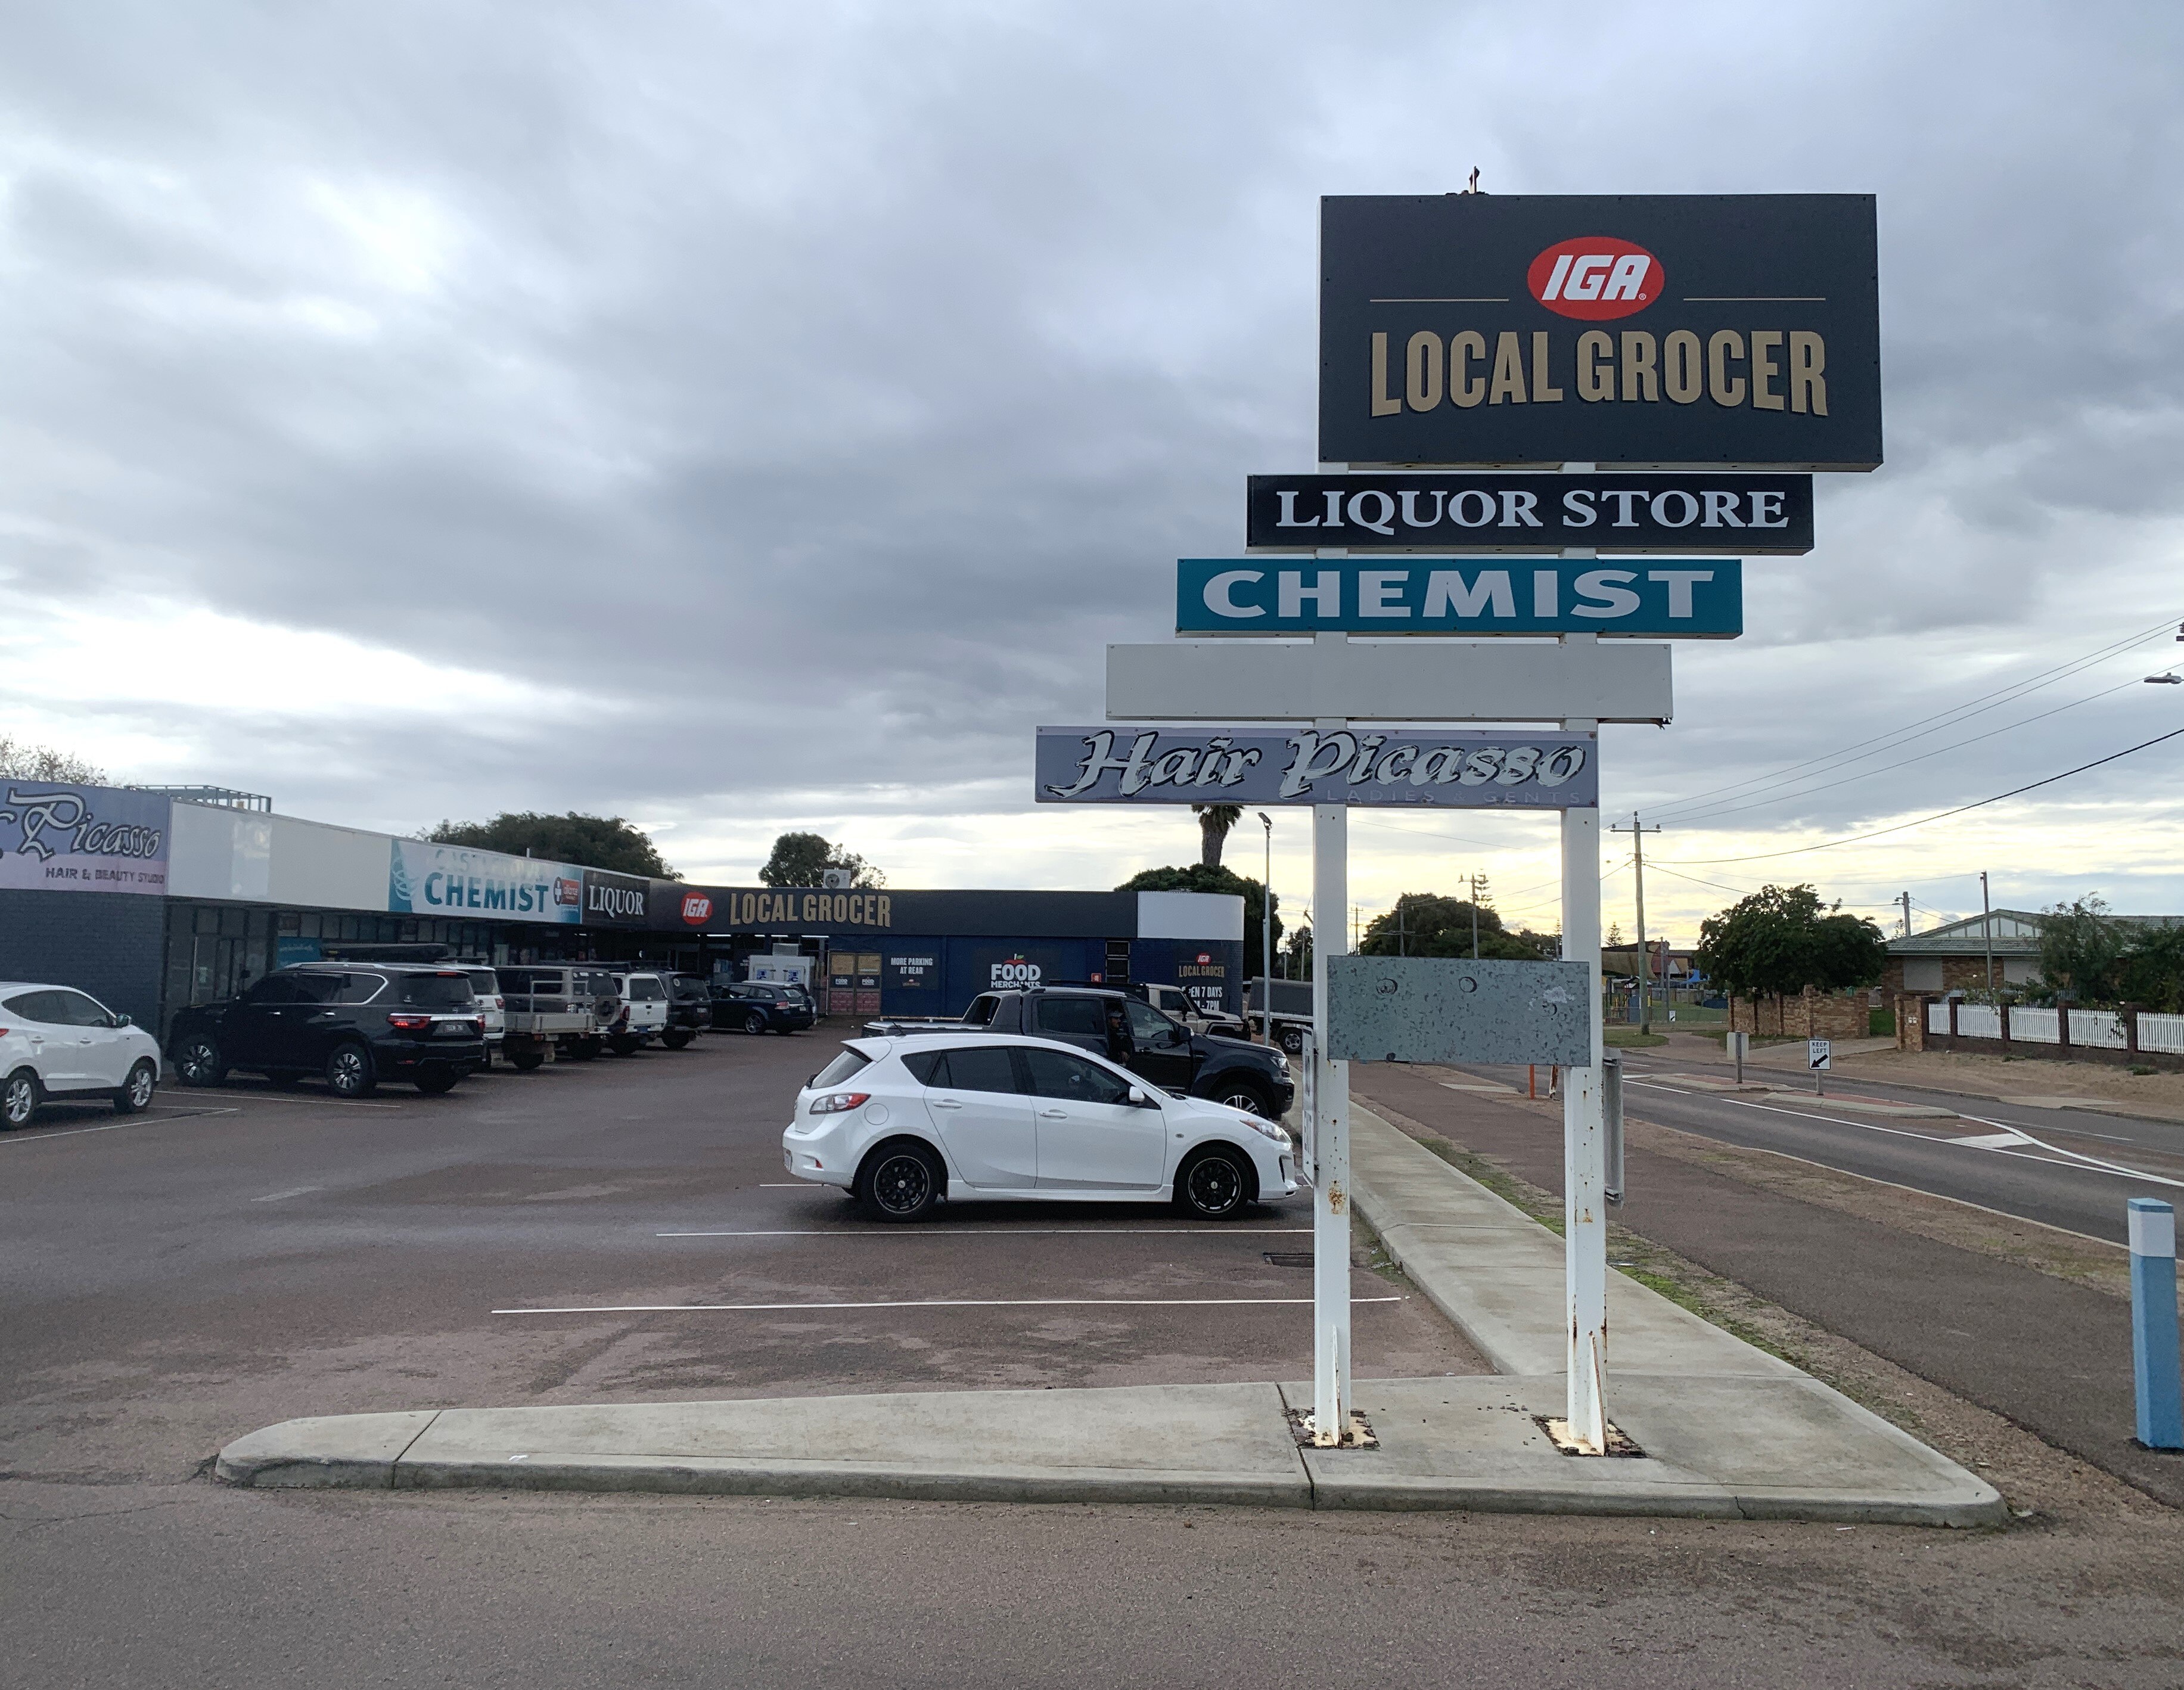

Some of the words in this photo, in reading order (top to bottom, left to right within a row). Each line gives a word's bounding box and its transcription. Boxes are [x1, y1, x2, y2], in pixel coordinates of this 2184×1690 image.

[1542, 254, 1651, 301] IGA
[1369, 330, 1563, 418] LOCAL
[1576, 329, 1829, 418] GROCER
[1276, 490, 1543, 536] LIQUOR
[1562, 490, 1790, 529] STORE
[1202, 570, 1714, 619] CHEMIST
[1044, 730, 1263, 799] Hair
[1279, 730, 1586, 800] Picasso
[1326, 790, 1435, 803] LADIES
[1483, 790, 1580, 803] GENTS
[5, 787, 162, 863] Picasso
[46, 867, 77, 880] HAIR
[82, 868, 91, 881] &
[95, 869, 134, 883] BEAUTY
[424, 872, 549, 913] CHEMIST
[588, 885, 644, 918] LIQUOR
[682, 898, 710, 917] IGA
[729, 893, 798, 925] LOCAL
[802, 893, 891, 927] GROCER
[900, 966, 908, 974] AT
[908, 966, 923, 974] REAR
[991, 964, 1041, 981] FOOD
[1179, 965, 1201, 977] LOCAL
[1201, 965, 1225, 978] GROCER
[1201, 986, 1206, 998] 7
[1207, 986, 1223, 998] DAYS
[1206, 1000, 1220, 1011] 7PM
